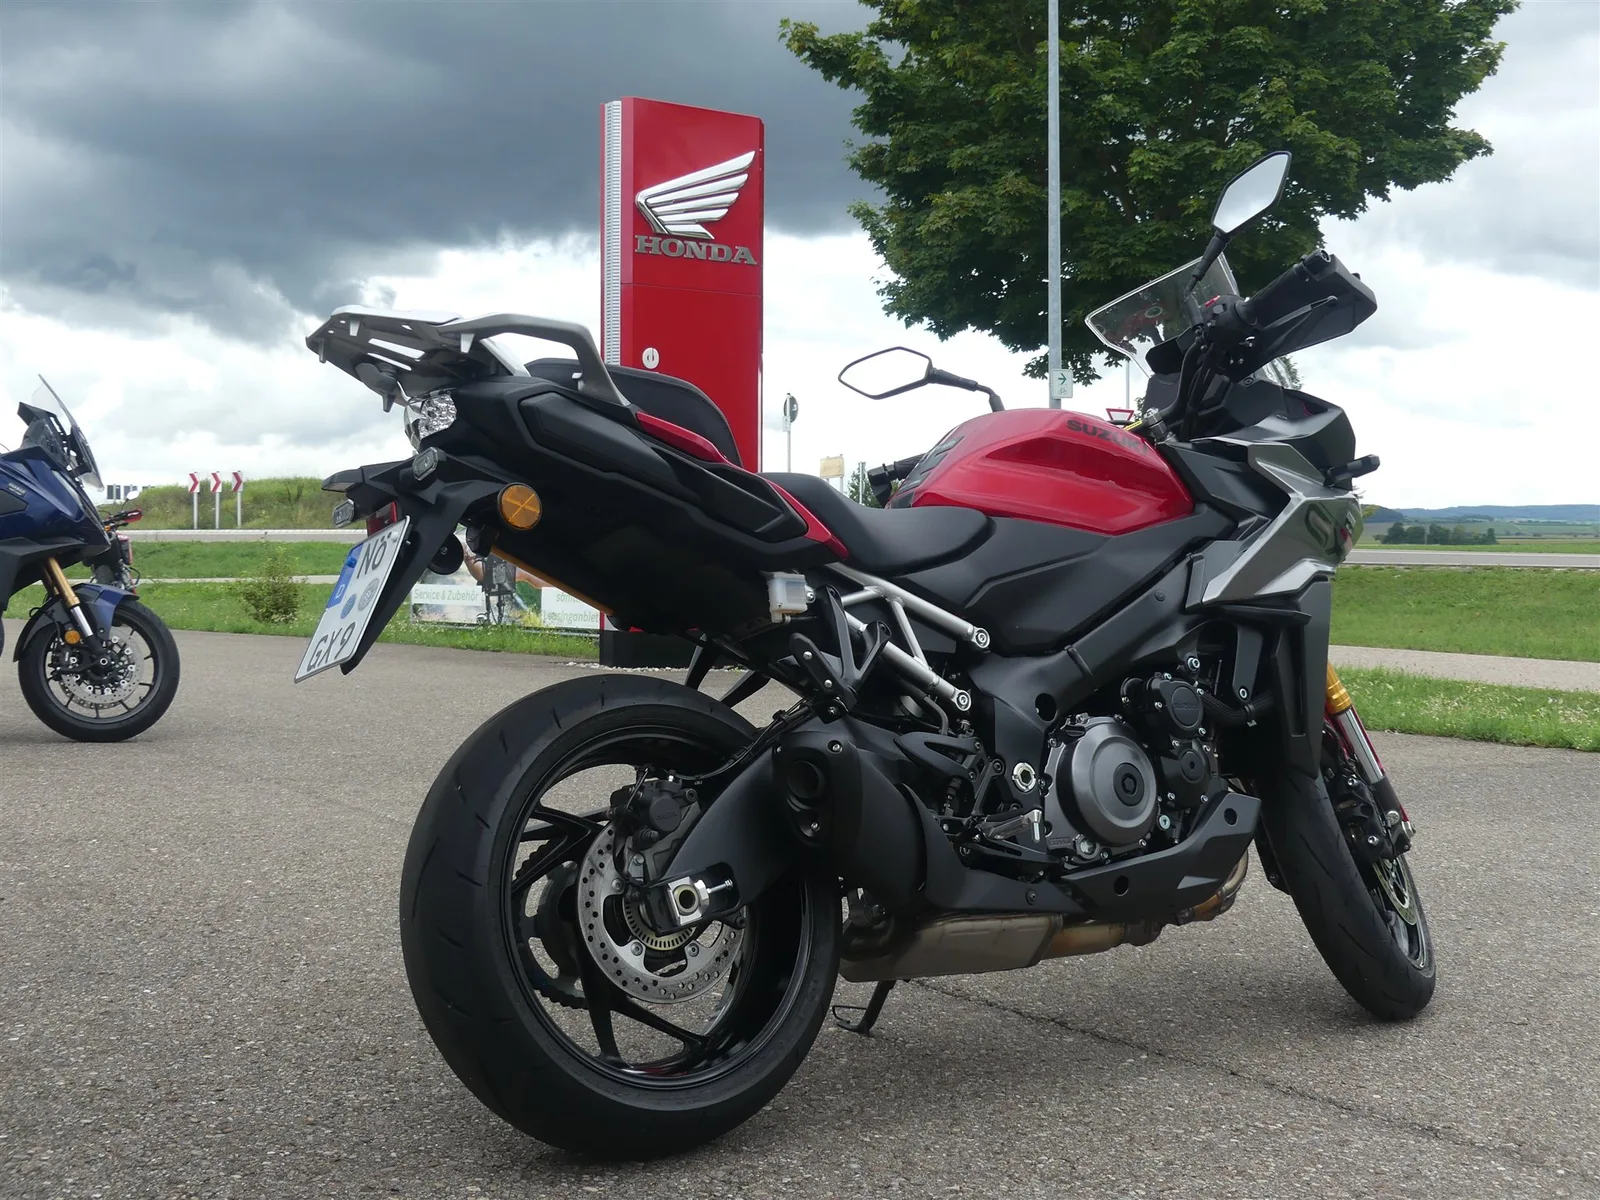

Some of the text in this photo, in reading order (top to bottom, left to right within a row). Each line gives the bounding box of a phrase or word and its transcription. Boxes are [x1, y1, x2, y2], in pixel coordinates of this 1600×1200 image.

[634, 234, 757, 266] HONDA
[1066, 419, 1148, 457] SUZUKI
[356, 531, 393, 579] NÖ
[336, 583, 346, 598] D
[414, 589, 479, 601] Service & Zubehör
